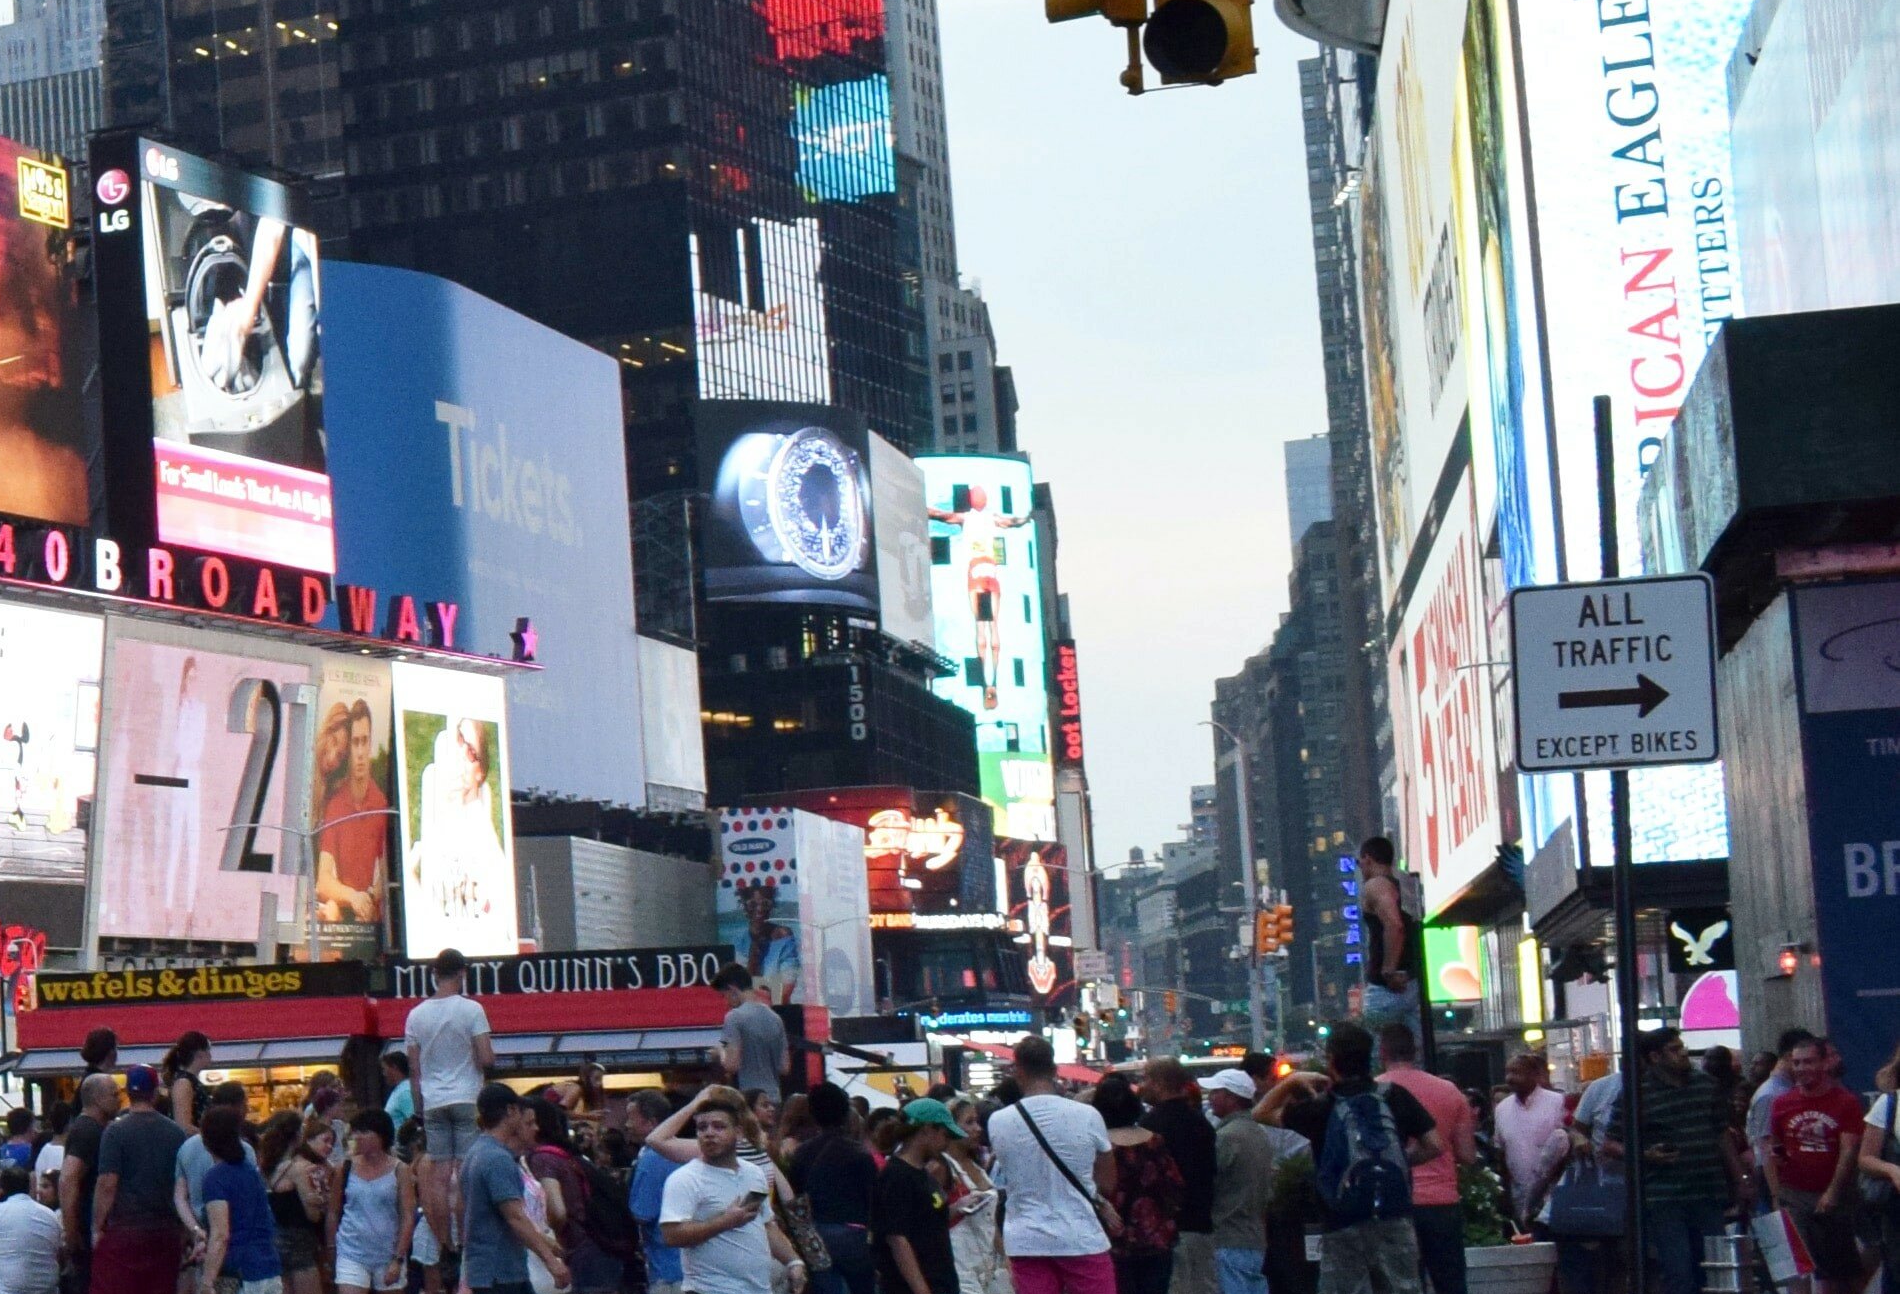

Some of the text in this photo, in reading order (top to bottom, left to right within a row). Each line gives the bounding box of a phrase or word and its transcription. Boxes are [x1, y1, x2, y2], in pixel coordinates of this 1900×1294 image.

[160, 157, 179, 181] LG
[100, 210, 130, 233] LG
[95, 539, 458, 648] BROADWAY
[1578, 594, 1644, 627] ALL
[1553, 634, 1672, 668] TRAFFIC
[850, 665, 867, 740] 1500
[1537, 729, 1698, 759] EXCEPT BIKES
[41, 974, 154, 1003] wafels
[190, 967, 300, 999] dinges
[519, 952, 721, 994] QUINN'S BBQ
